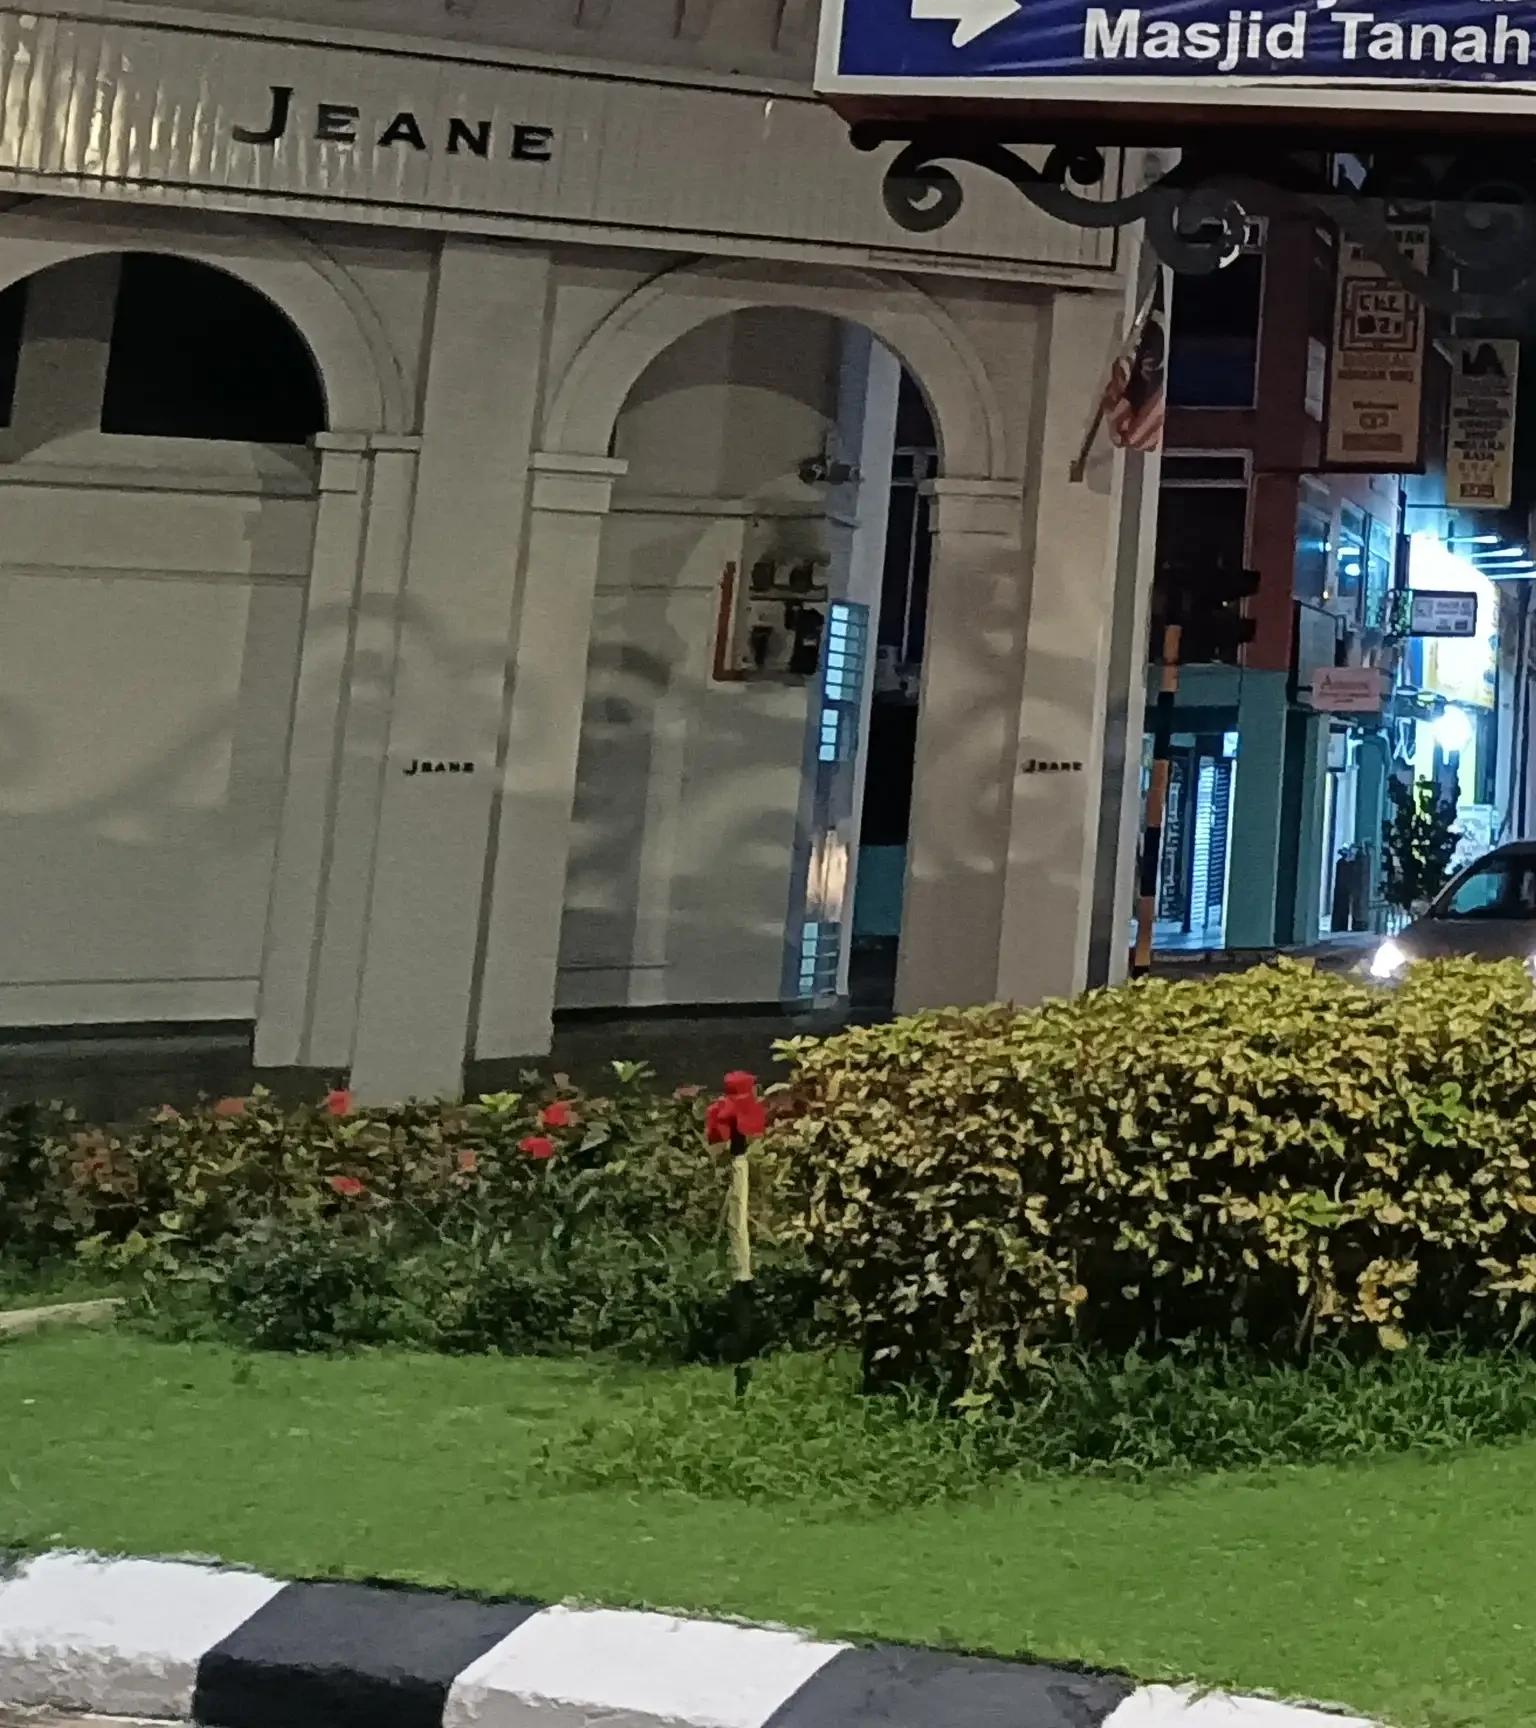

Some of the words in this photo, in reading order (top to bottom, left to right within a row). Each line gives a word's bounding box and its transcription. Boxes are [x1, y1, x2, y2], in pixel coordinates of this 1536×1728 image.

[1083, 9, 1305, 71] Masjid
[1331, 12, 1531, 65] Tanah
[232, 85, 553, 161] JEANE
